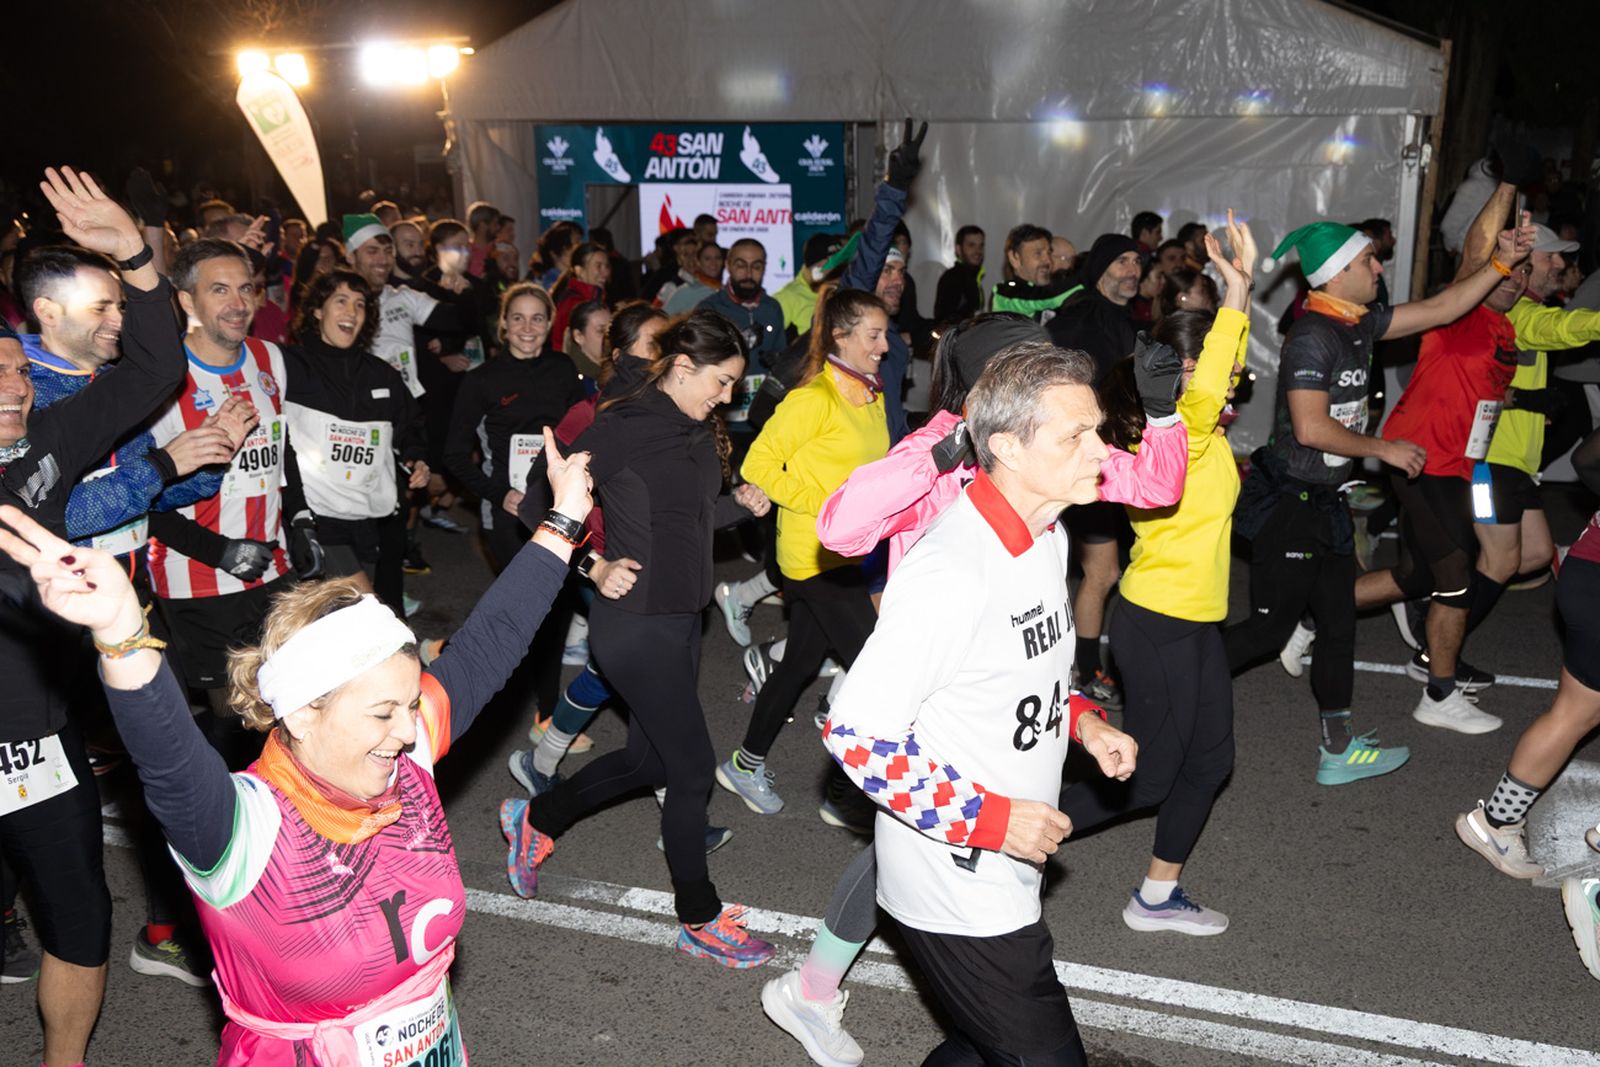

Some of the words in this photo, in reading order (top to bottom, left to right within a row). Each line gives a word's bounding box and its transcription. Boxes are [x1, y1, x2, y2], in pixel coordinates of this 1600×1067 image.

[644, 151, 721, 179] ANTÓN
[752, 157, 767, 174] 43
[716, 208, 751, 225] SAN
[338, 428, 357, 436] NOCHE
[239, 444, 278, 472] 4908
[331, 443, 375, 466] 5065
[1010, 600, 1045, 628] hummel
[1022, 611, 1062, 660] REAL
[397, 1008, 437, 1042] NOCHE
[436, 1000, 445, 1019] DE
[383, 1043, 414, 1067] SAN
